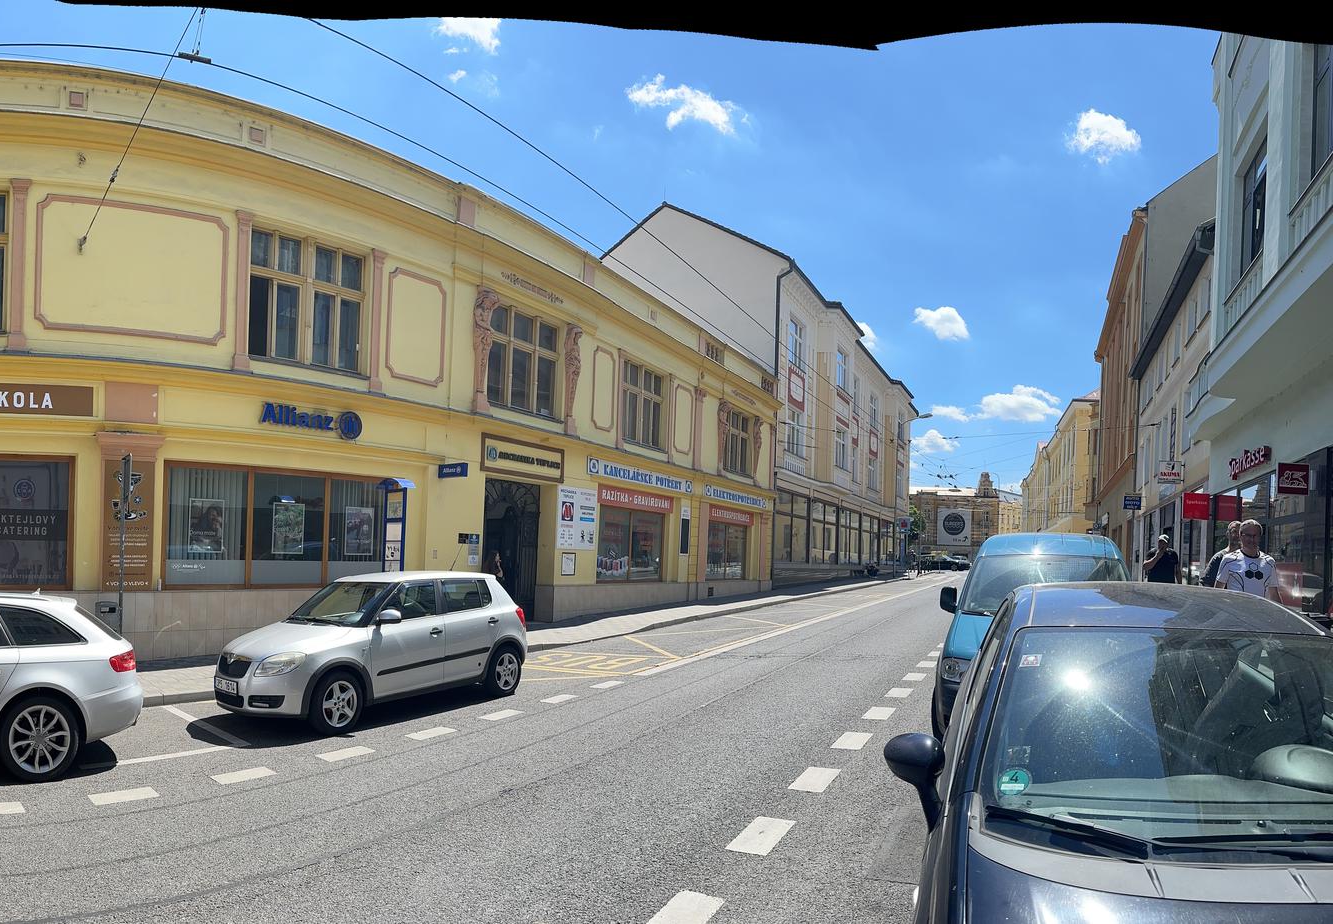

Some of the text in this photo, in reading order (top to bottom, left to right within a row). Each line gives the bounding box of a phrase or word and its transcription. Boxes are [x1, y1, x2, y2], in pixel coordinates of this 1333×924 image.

[261, 402, 334, 432] Allianz
[655, 476, 683, 491] POTŘEBY
[601, 488, 629, 503] RAZÍTKA
[1009, 771, 1019, 783] 4
